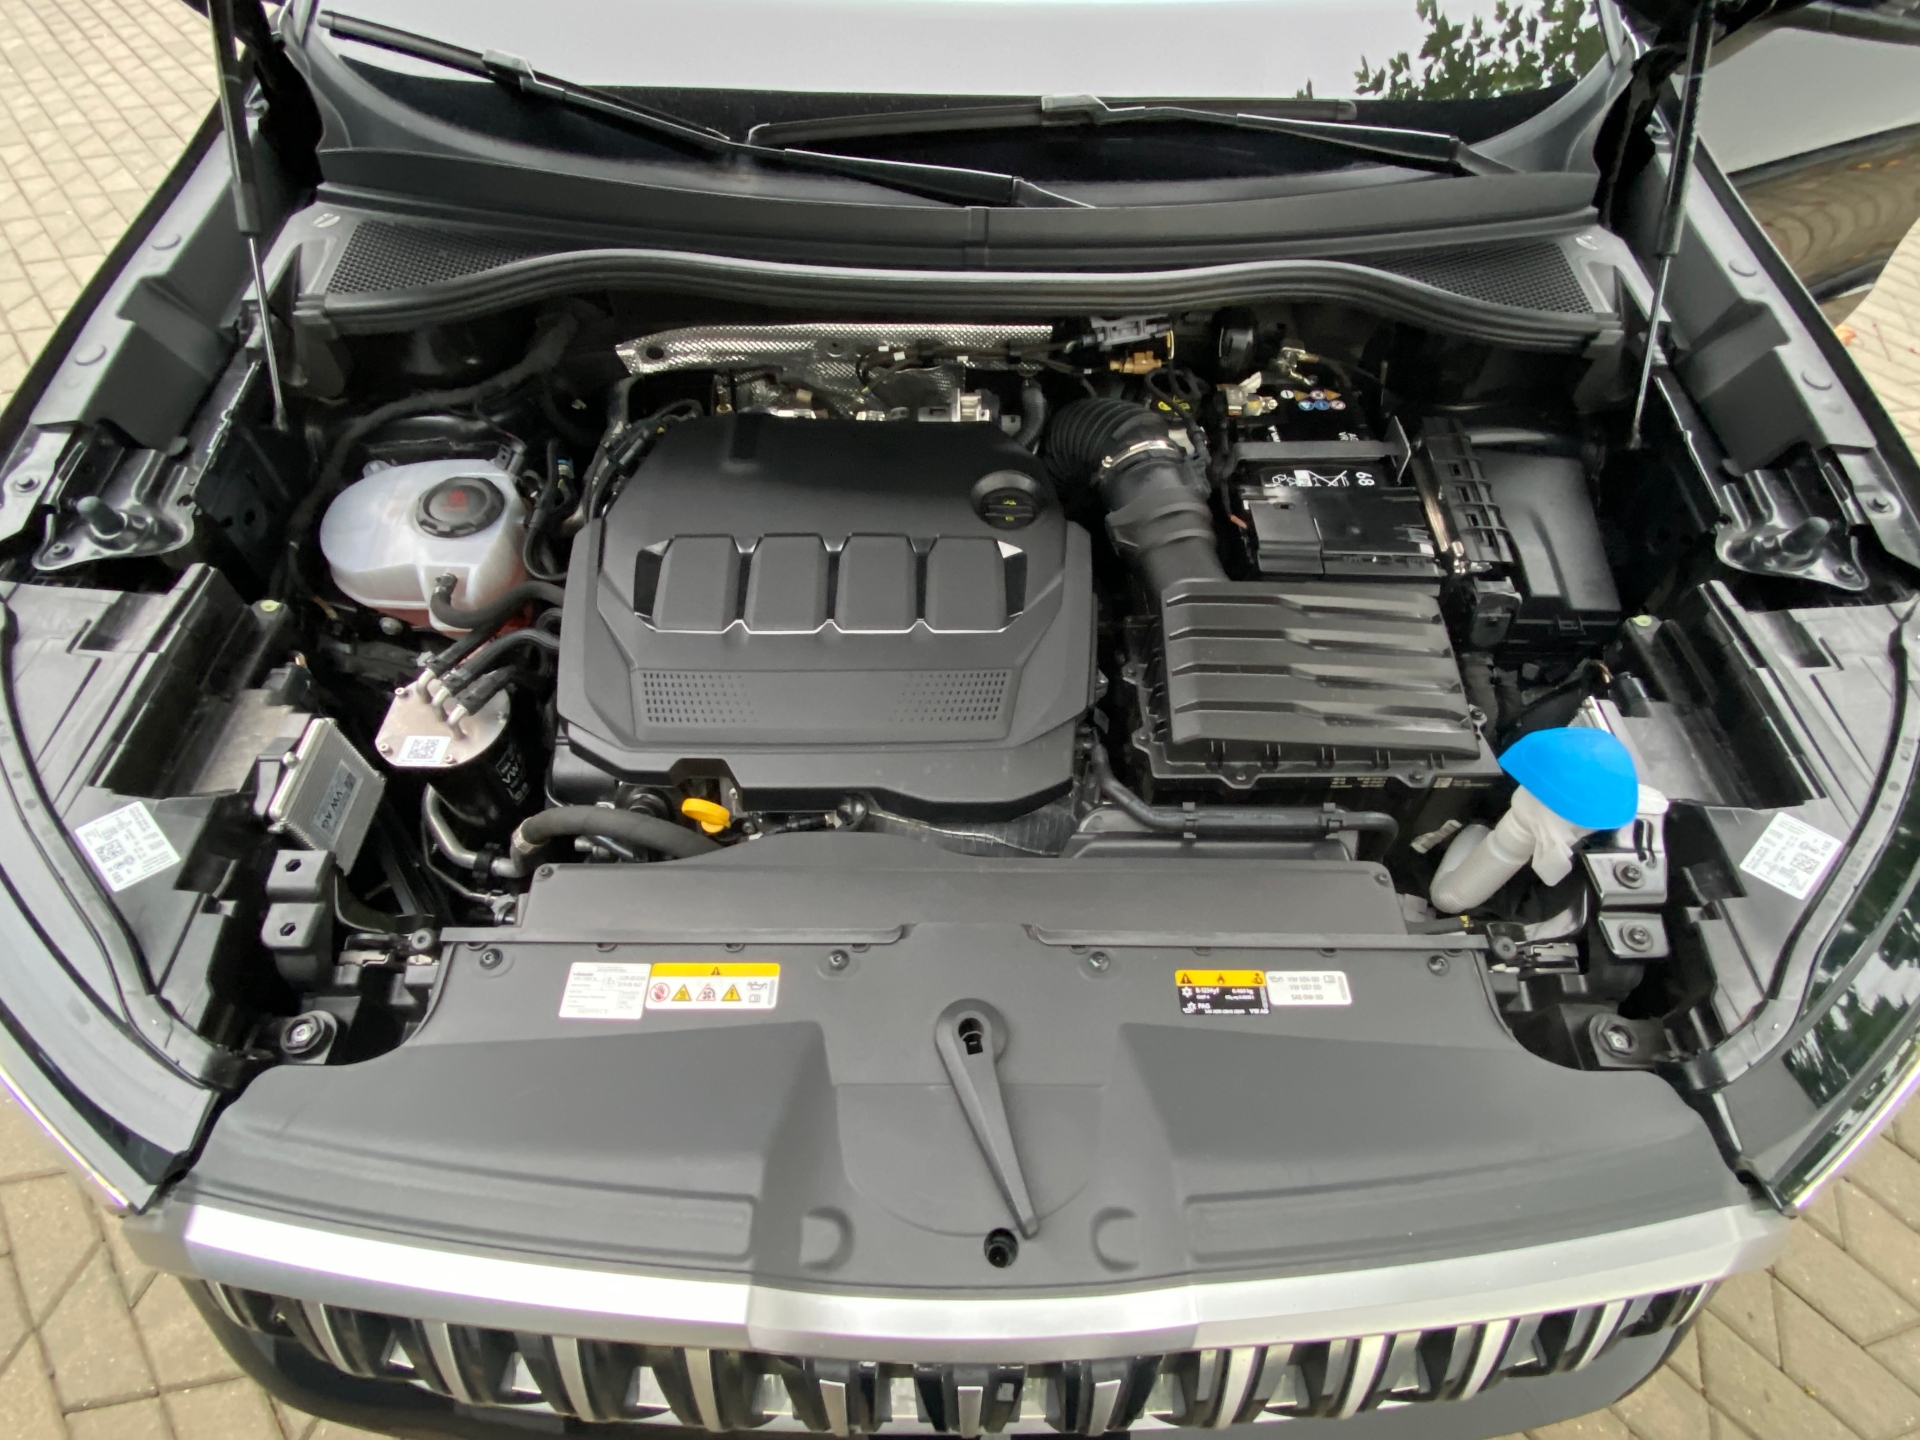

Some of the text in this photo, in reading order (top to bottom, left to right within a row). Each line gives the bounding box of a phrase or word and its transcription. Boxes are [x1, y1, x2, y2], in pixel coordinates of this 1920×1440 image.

[1355, 471, 1375, 487] 68
[501, 762, 519, 784] VW
[321, 790, 343, 830] VW AG
